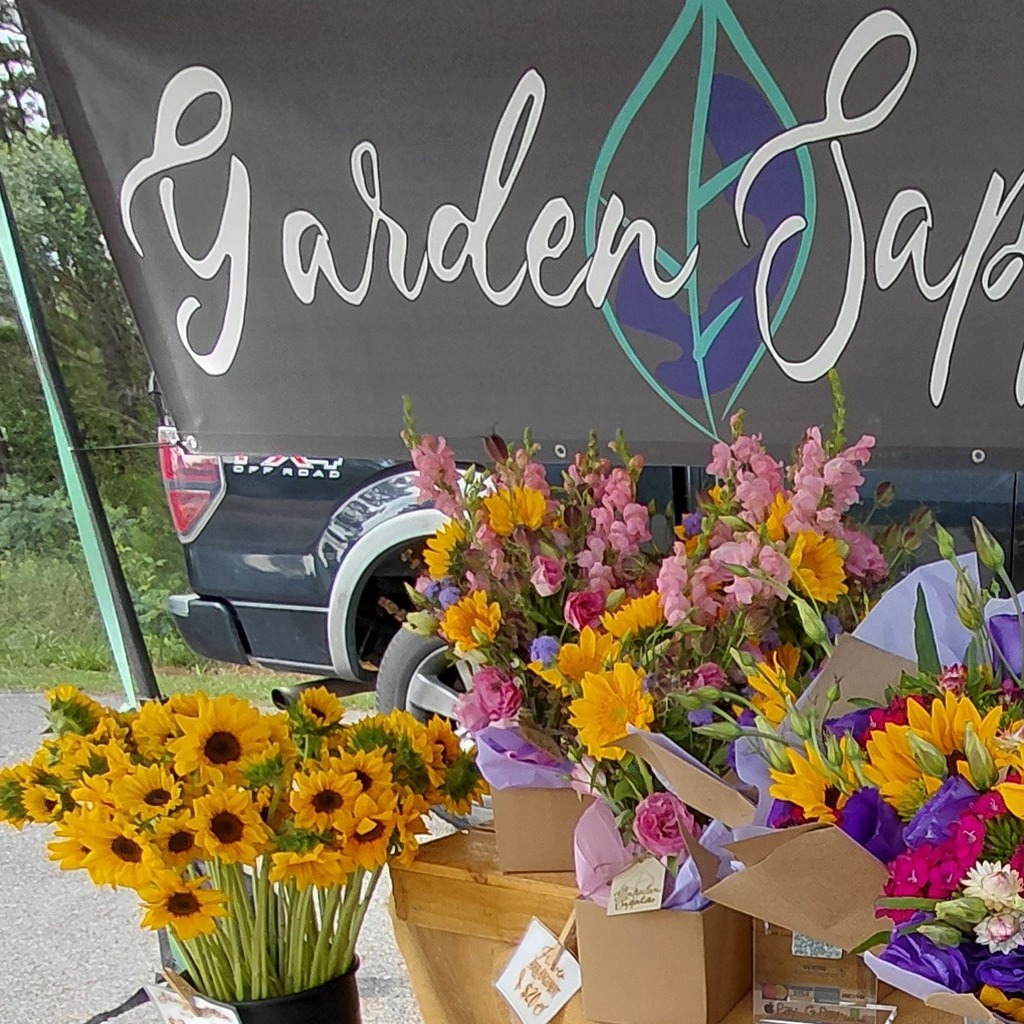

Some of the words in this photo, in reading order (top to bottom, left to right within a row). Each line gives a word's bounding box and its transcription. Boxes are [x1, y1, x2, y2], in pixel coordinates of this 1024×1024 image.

[120, 66, 700, 376] Garden
[232, 465, 274, 475] OFF
[282, 467, 341, 479] ROAD
